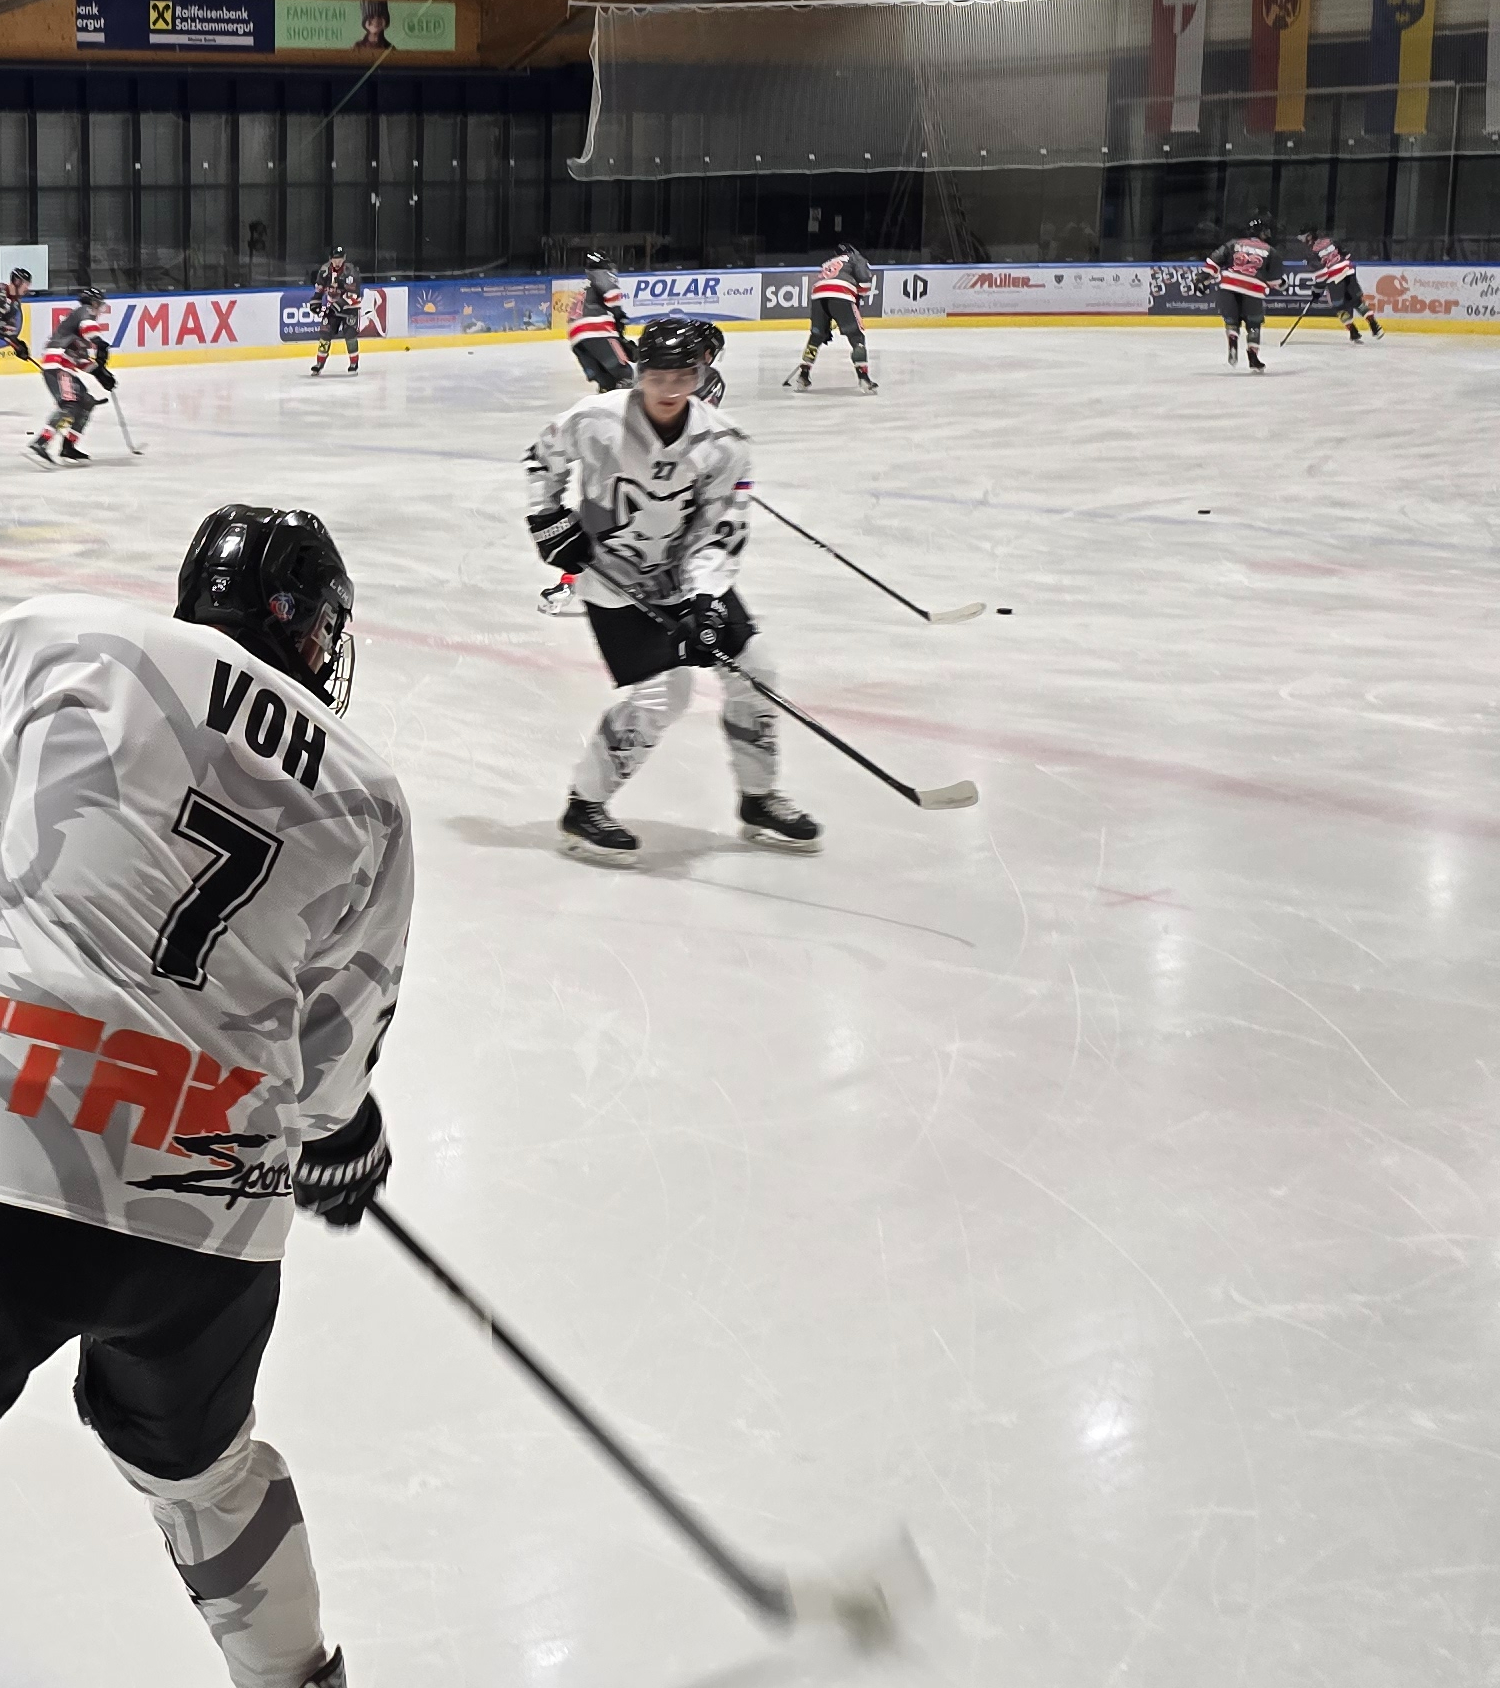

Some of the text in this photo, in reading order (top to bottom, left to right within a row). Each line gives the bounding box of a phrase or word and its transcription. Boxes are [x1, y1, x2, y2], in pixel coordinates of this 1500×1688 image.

[175, 5, 248, 20] Raiffeisenbank
[175, 18, 253, 35] Salzkammergut
[633, 277, 721, 299] POLAR
[1362, 294, 1460, 315] Gruber
[651, 460, 678, 481] 27
[206, 658, 327, 791] VOH
[151, 786, 284, 992] 7
